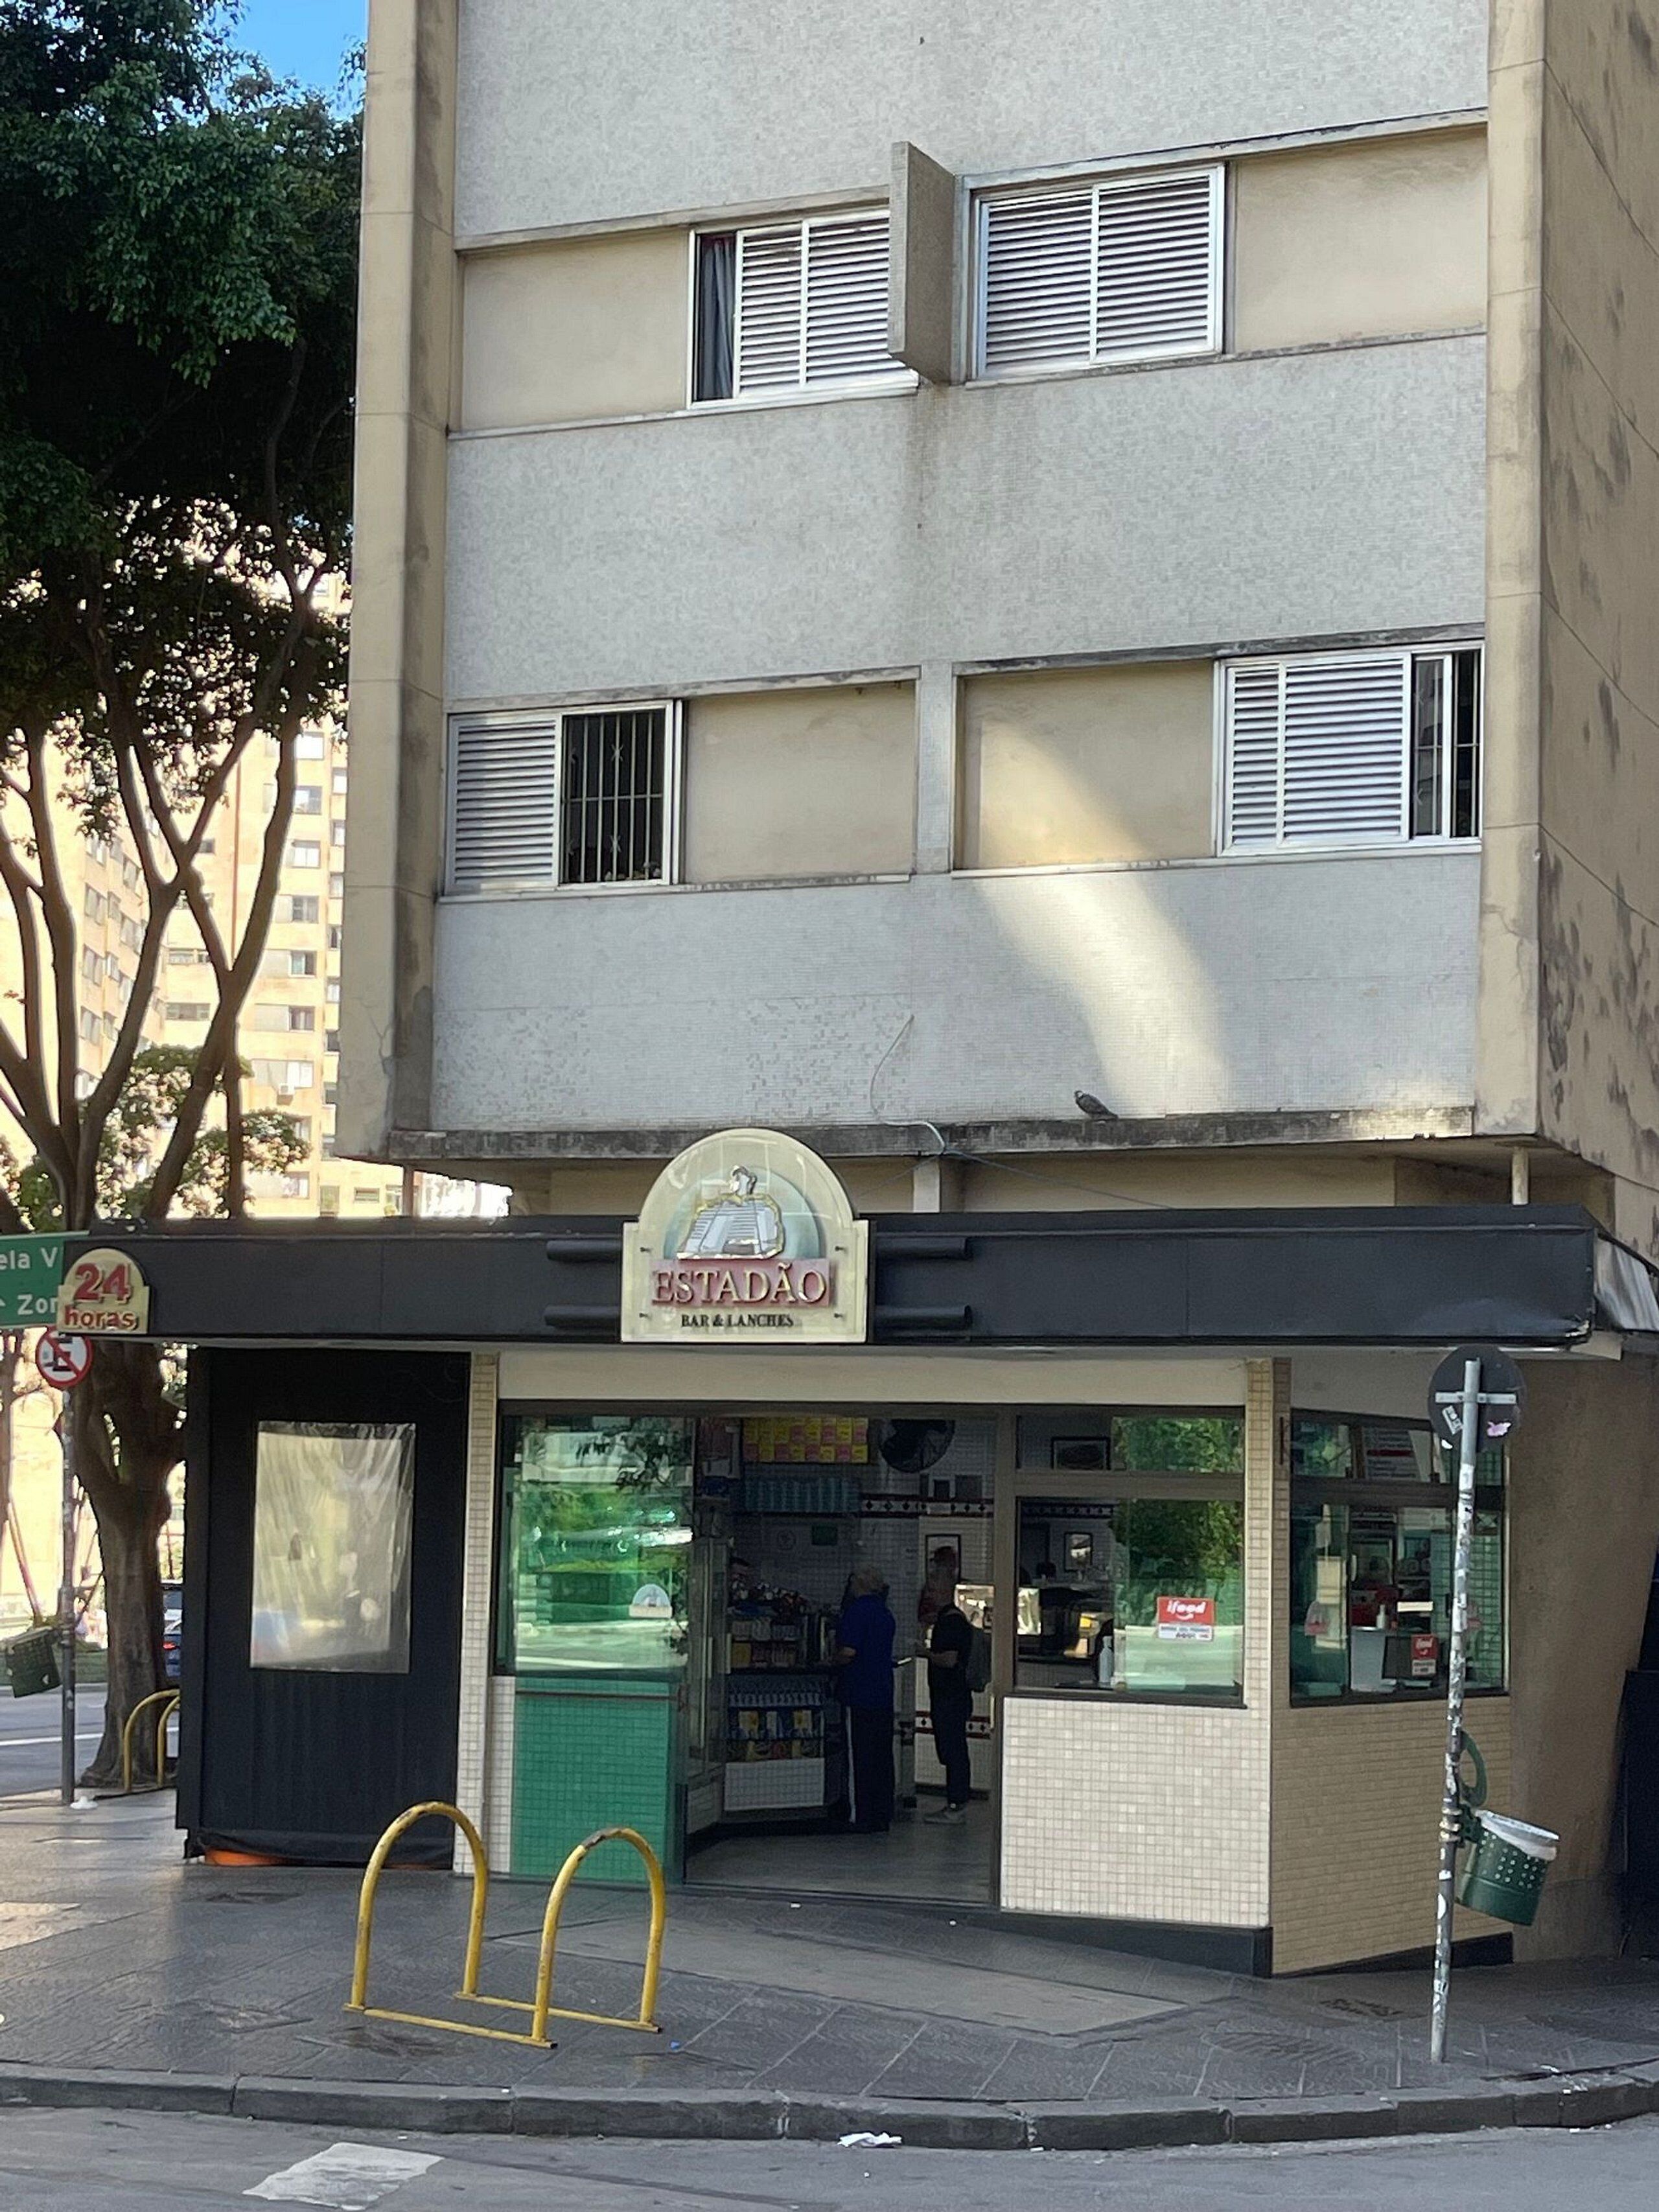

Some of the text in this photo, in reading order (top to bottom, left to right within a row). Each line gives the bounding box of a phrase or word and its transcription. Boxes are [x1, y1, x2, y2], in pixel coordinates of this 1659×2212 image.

[75, 1263, 130, 1301] 24
[652, 1263, 827, 1303] ESTADÃO
[64, 1305, 137, 1328] horas
[682, 1314, 794, 1327] BAR & LANCHES
